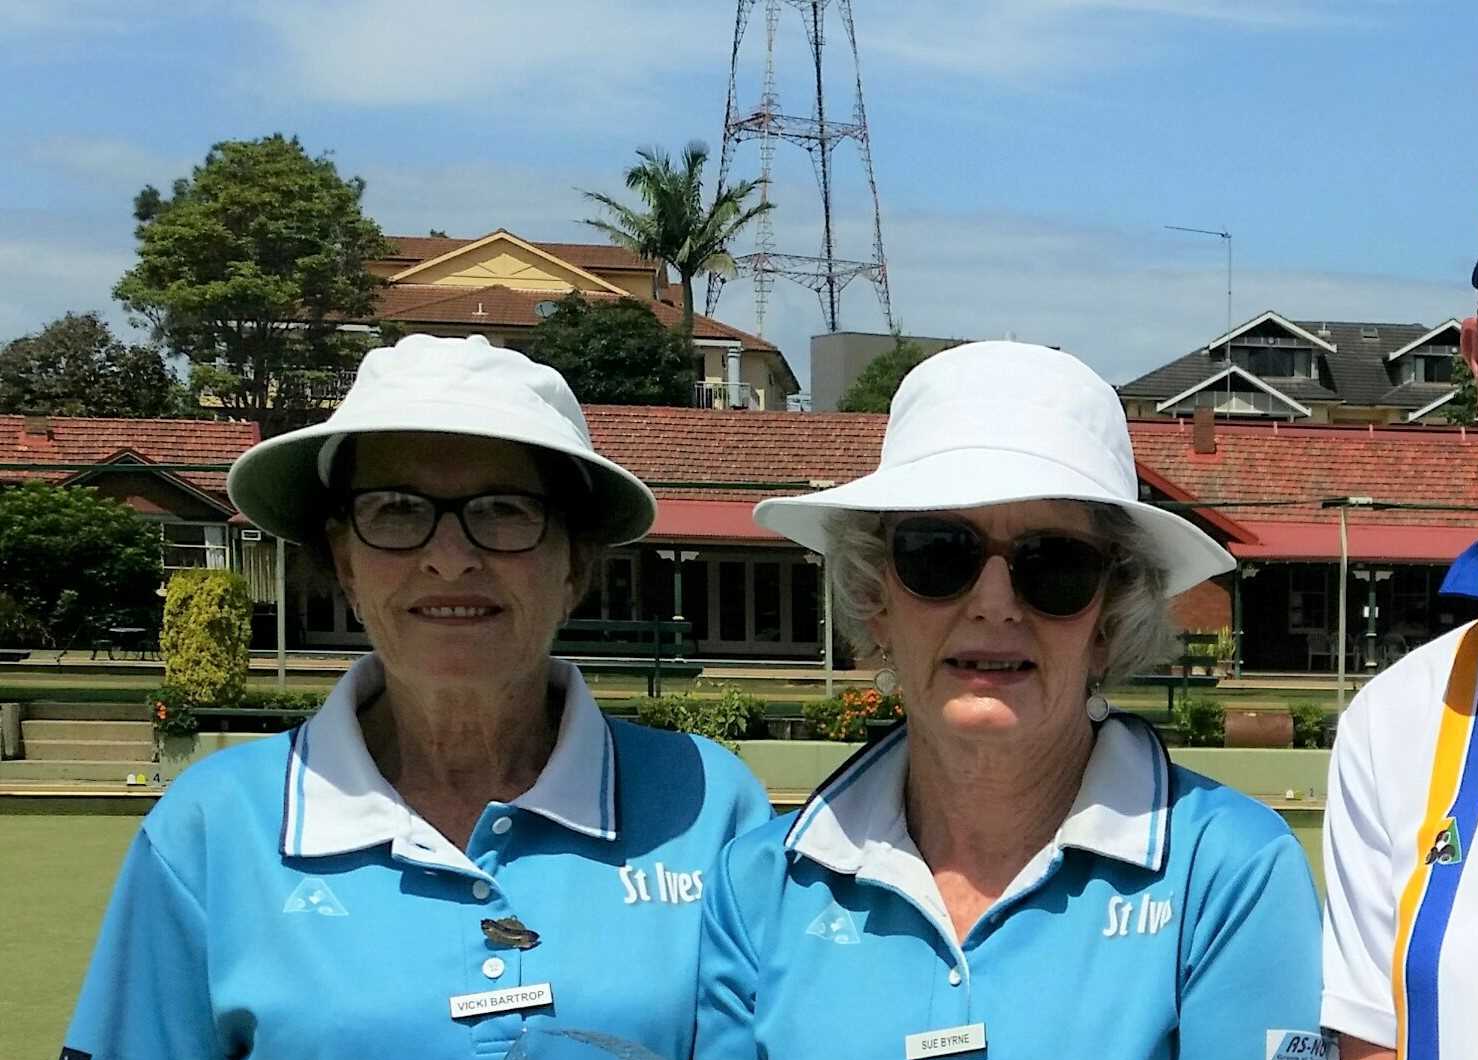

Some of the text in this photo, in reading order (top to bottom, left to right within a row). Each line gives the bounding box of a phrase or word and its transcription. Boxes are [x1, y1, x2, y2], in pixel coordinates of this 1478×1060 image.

[619, 862, 703, 904] St Ives
[1102, 895, 1133, 937] St
[456, 990, 545, 1011] VICKI BARTROP
[921, 1033, 970, 1050] SUE BYRNE
